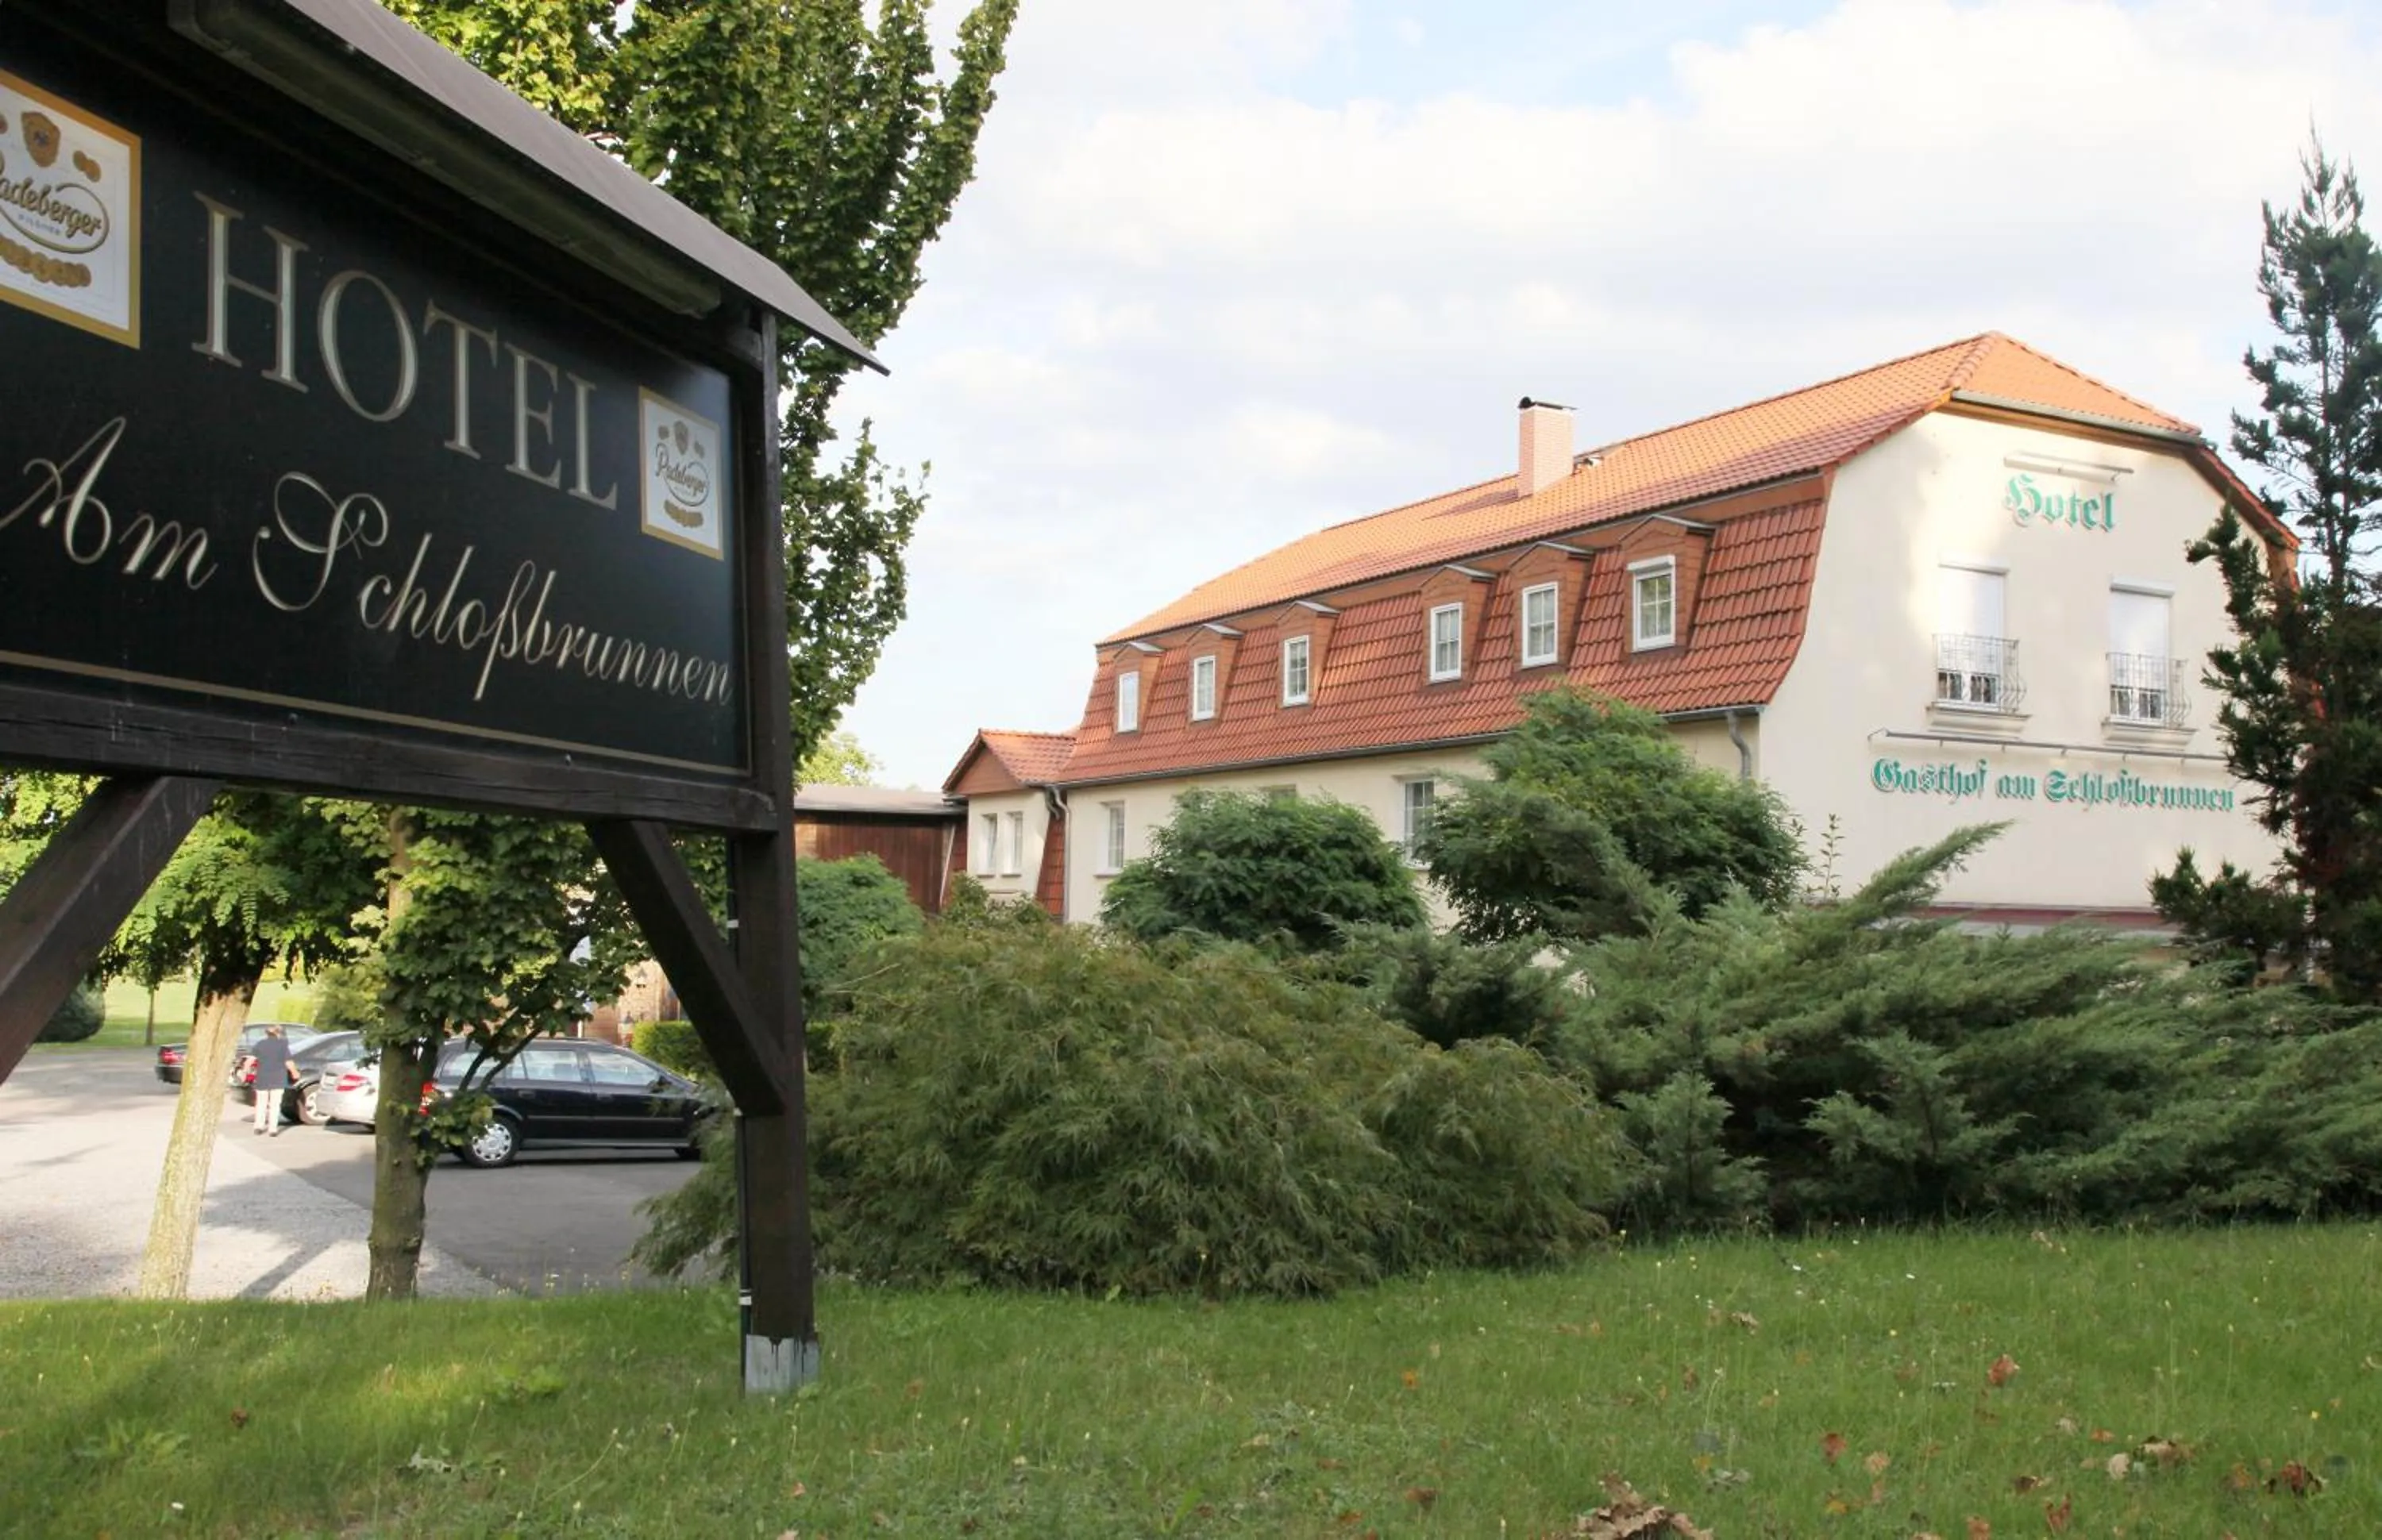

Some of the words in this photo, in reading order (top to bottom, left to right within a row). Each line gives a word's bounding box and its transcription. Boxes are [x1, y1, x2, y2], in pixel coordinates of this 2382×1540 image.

[0, 152, 102, 239] adeberger
[191, 190, 619, 510] HOTEL
[2004, 472, 2118, 533] Hotel
[0, 416, 218, 590] Am
[252, 471, 734, 706] Schloßbrunnen
[1871, 757, 1987, 804] Gasthof
[1995, 774, 2037, 800] am
[2044, 768, 2234, 812] Schloßbrunnen
